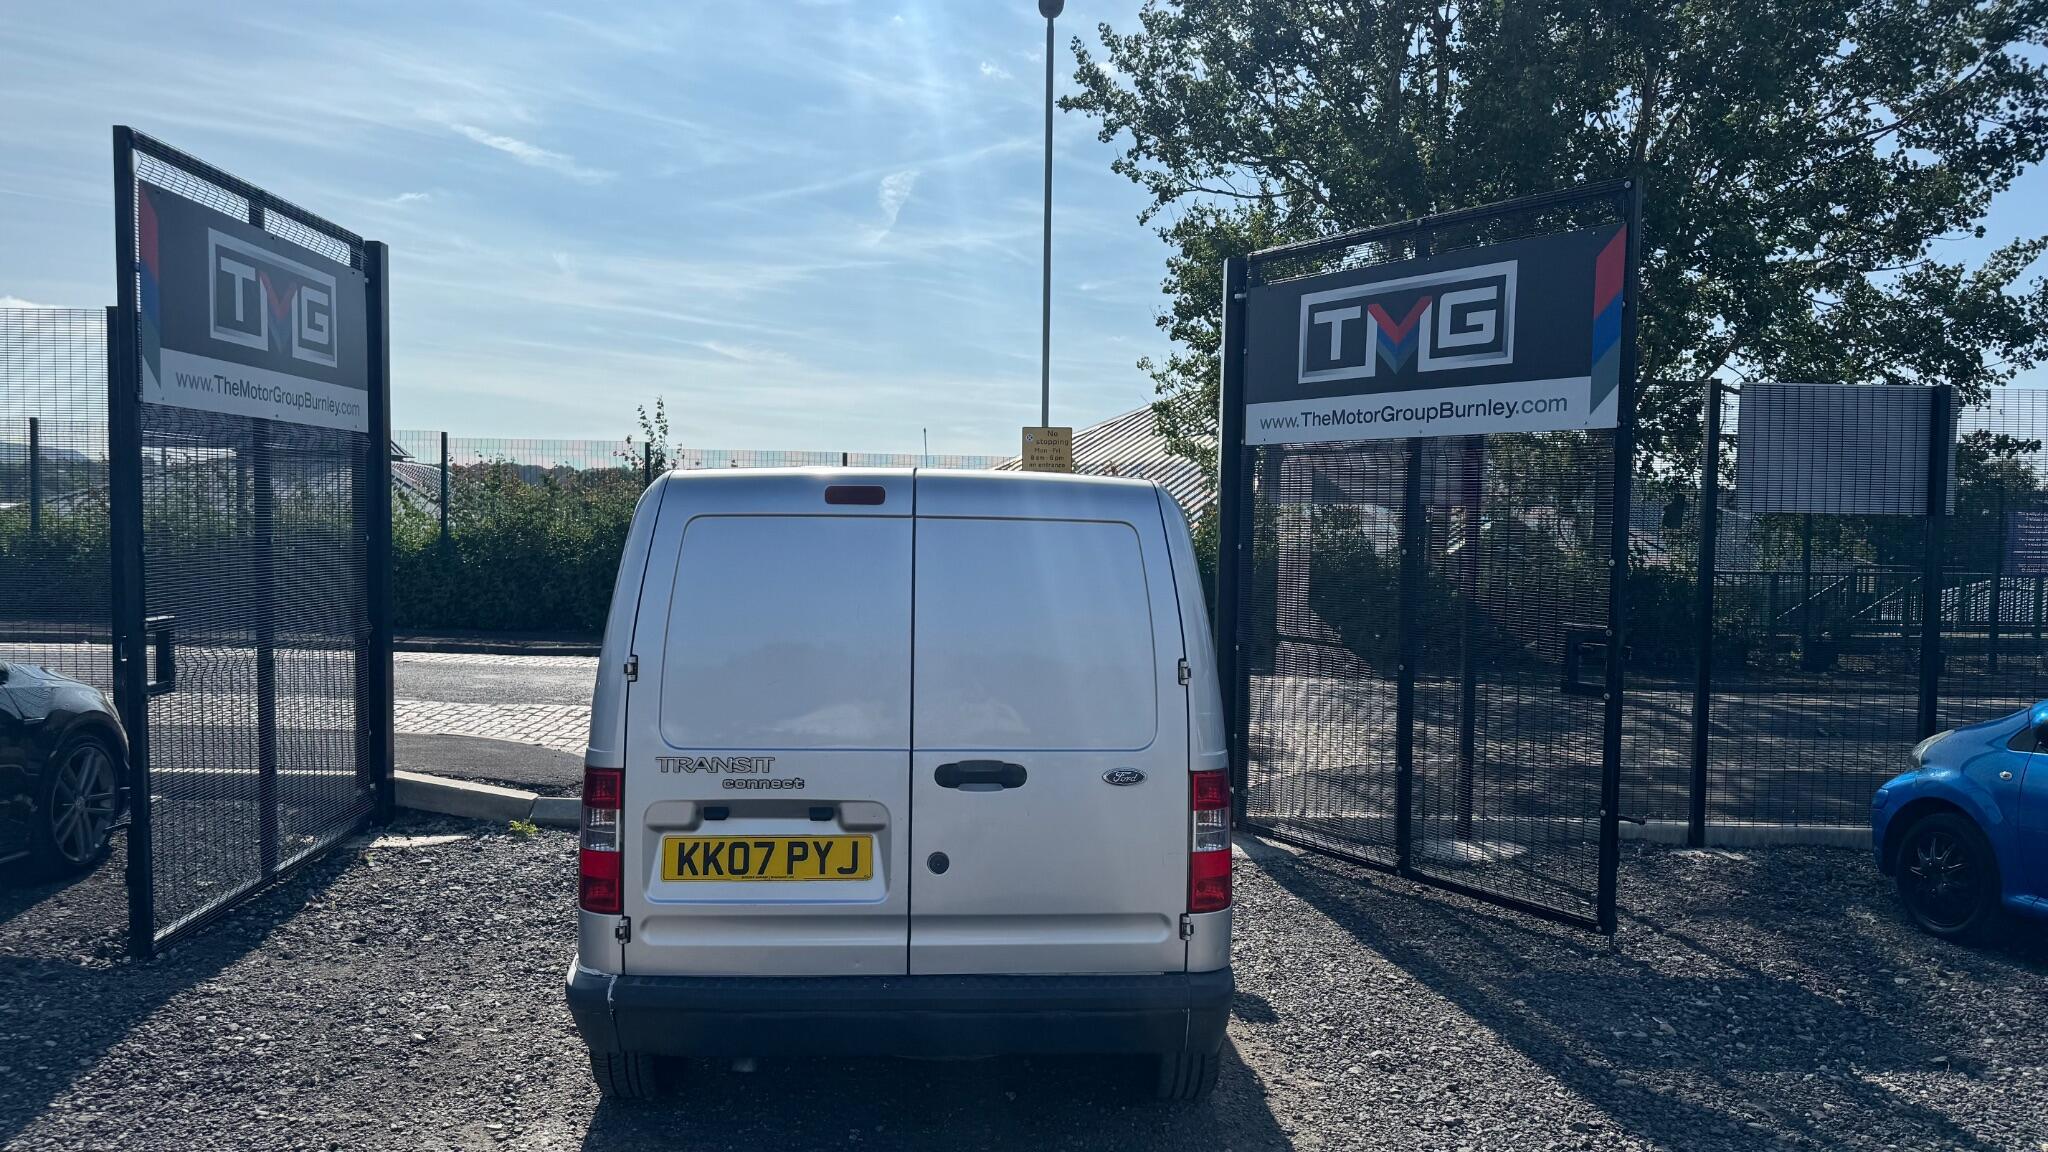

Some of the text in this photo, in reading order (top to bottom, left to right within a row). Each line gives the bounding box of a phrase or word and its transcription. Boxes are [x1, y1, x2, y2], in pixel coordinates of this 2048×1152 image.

[220, 256, 329, 352] TMG
[1314, 285, 1498, 375] TMG
[175, 371, 360, 417] www.TheMotorGroupBurnley.com
[1259, 395, 1568, 431] www.TheMotorGroupBurnley.com
[655, 756, 776, 774] TRANSIT
[1112, 771, 1139, 782] Ford
[722, 777, 805, 790] connect
[677, 841, 859, 876] KK07 PYJ
